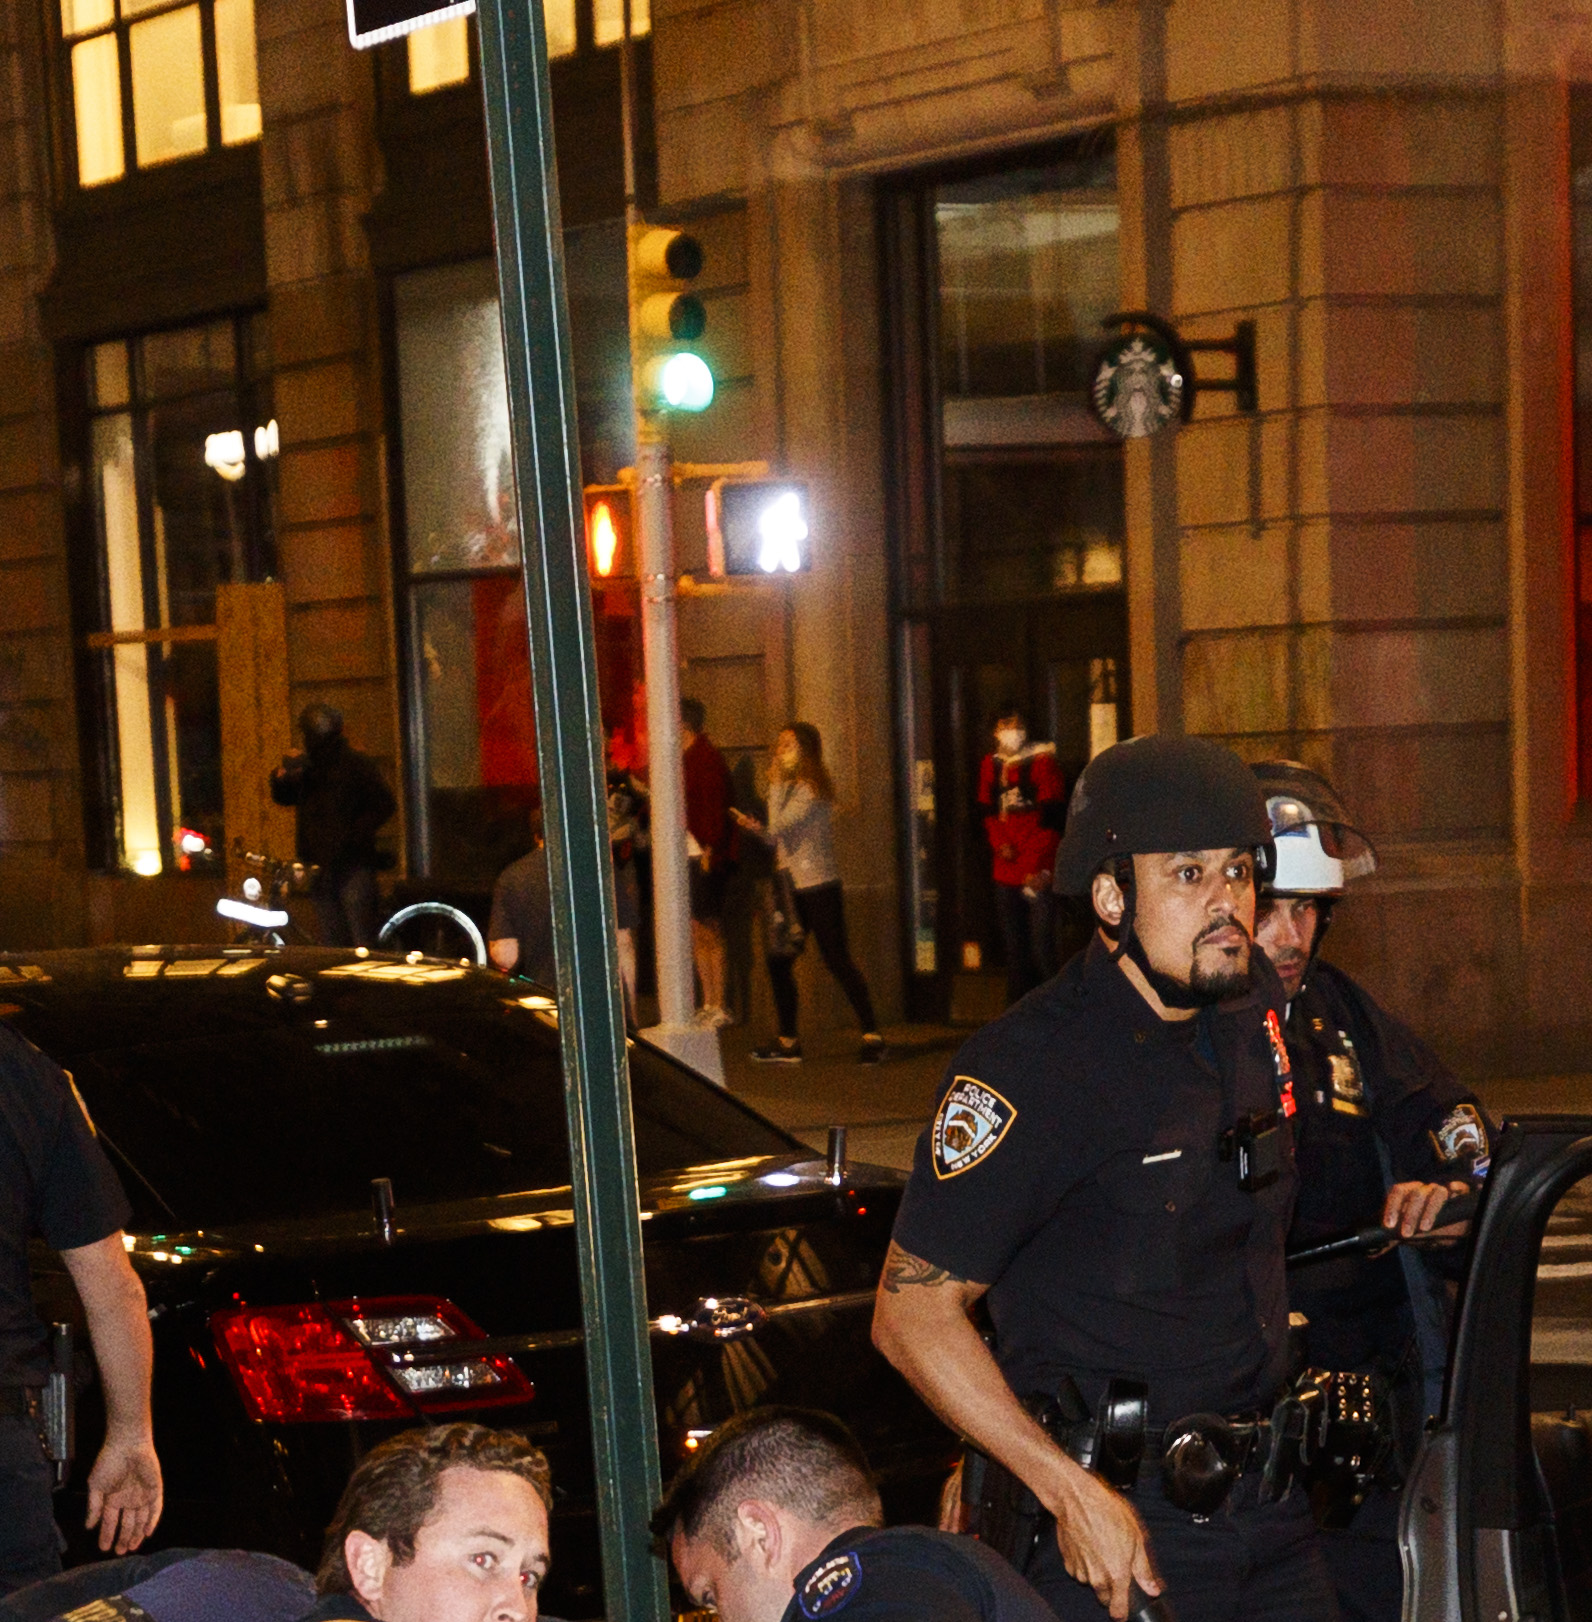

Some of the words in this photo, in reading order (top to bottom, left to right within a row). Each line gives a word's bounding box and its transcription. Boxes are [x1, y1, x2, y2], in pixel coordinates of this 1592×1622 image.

[948, 1091, 1003, 1128] DEPARTMENT
[963, 1083, 997, 1109] POLICE
[950, 1155, 971, 1171] NEW
[971, 1132, 998, 1158] YORK
